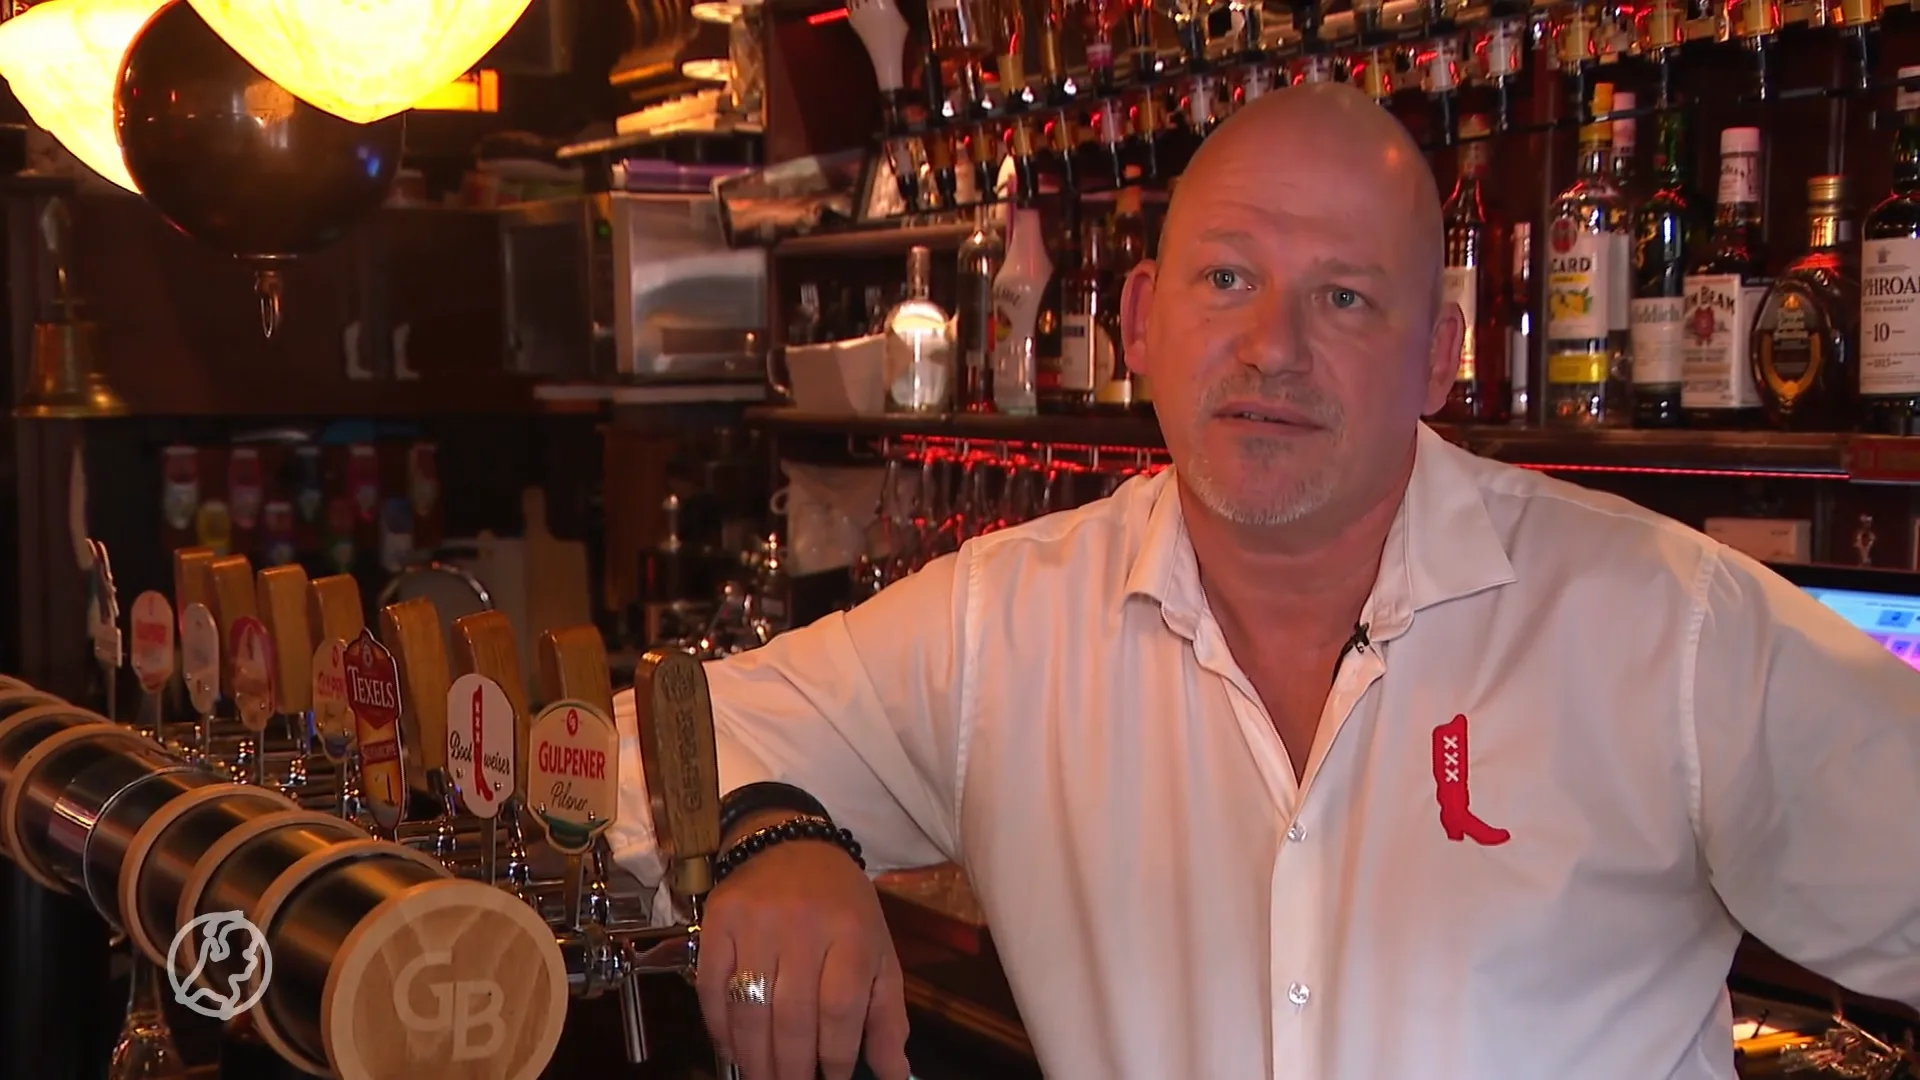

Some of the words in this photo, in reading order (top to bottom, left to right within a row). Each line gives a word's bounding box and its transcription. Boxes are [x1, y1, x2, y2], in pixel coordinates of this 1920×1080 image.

[1700, 285, 1735, 316] BEAM
[1874, 322, 1890, 342] 10
[347, 666, 395, 709] TEXELS
[538, 740, 605, 780] GULPENER
[550, 781, 588, 812] Pilsner
